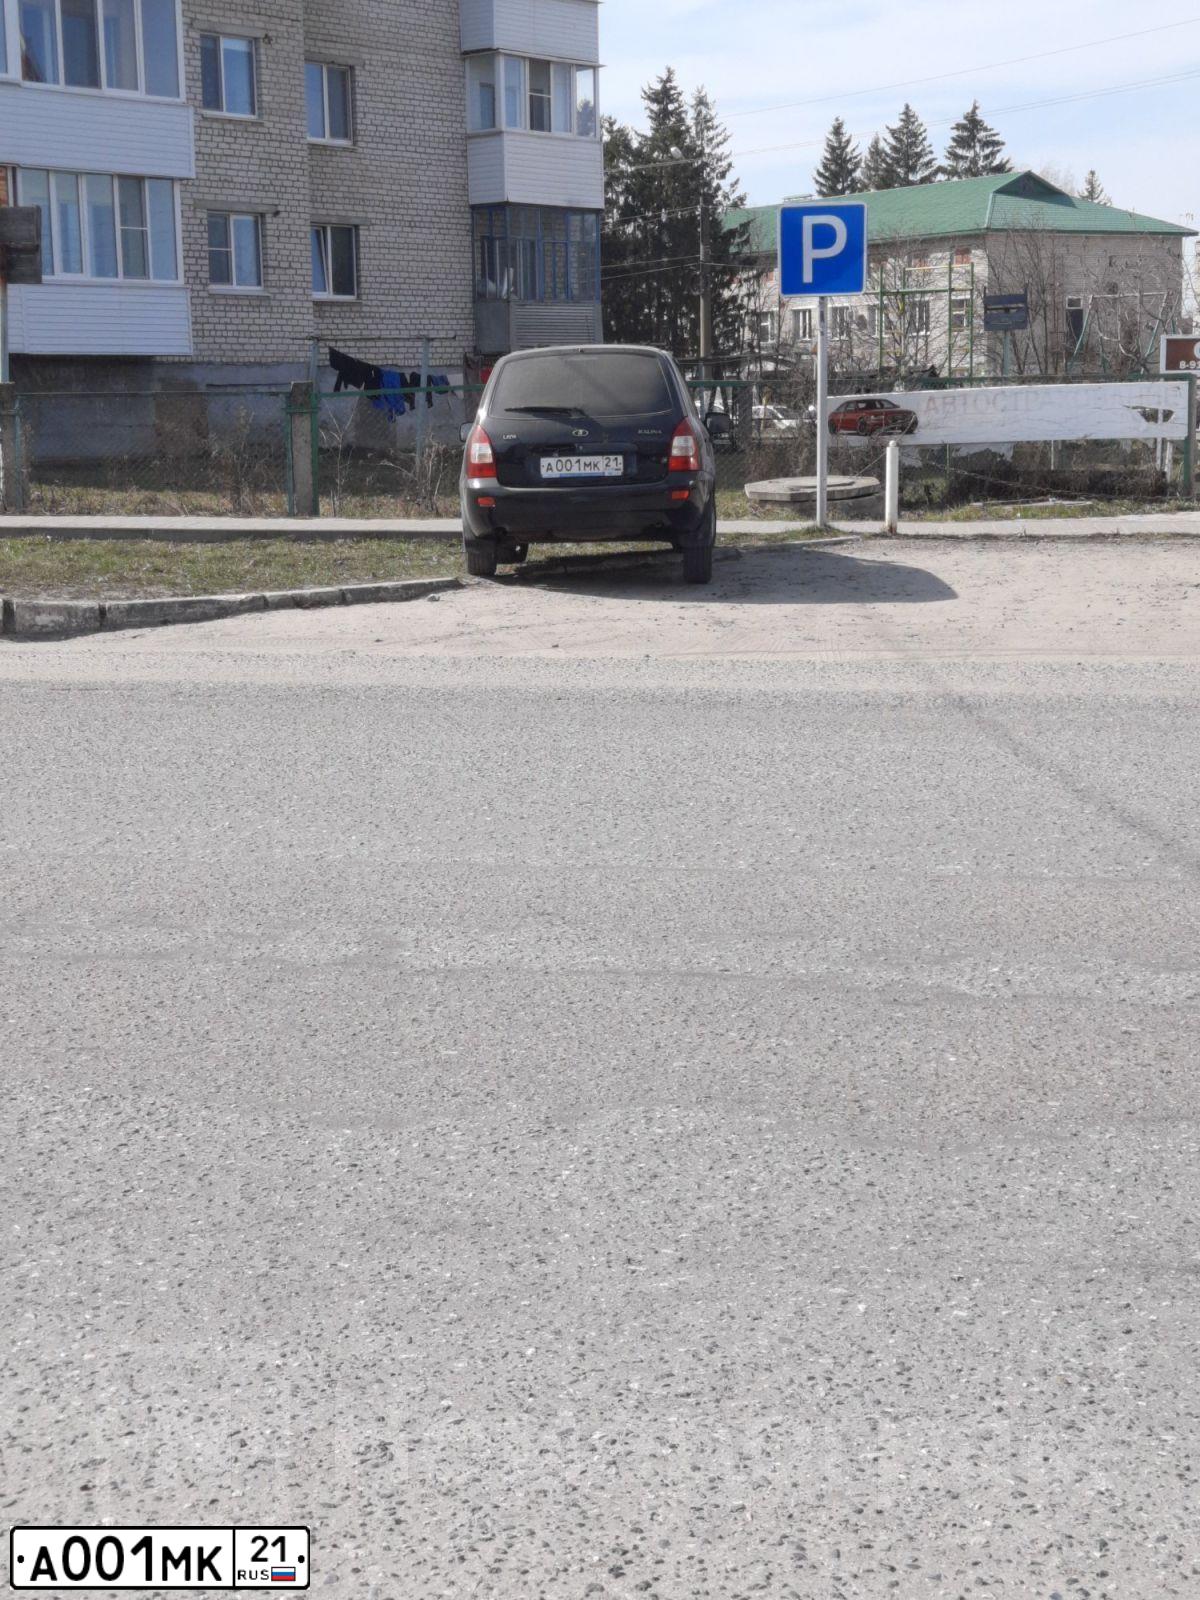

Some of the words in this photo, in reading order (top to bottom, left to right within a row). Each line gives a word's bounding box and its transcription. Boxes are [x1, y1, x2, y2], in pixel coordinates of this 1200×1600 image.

[803, 215, 847, 283] P
[1179, 360, 1200, 369] 8-9
[605, 456, 619, 468] 21
